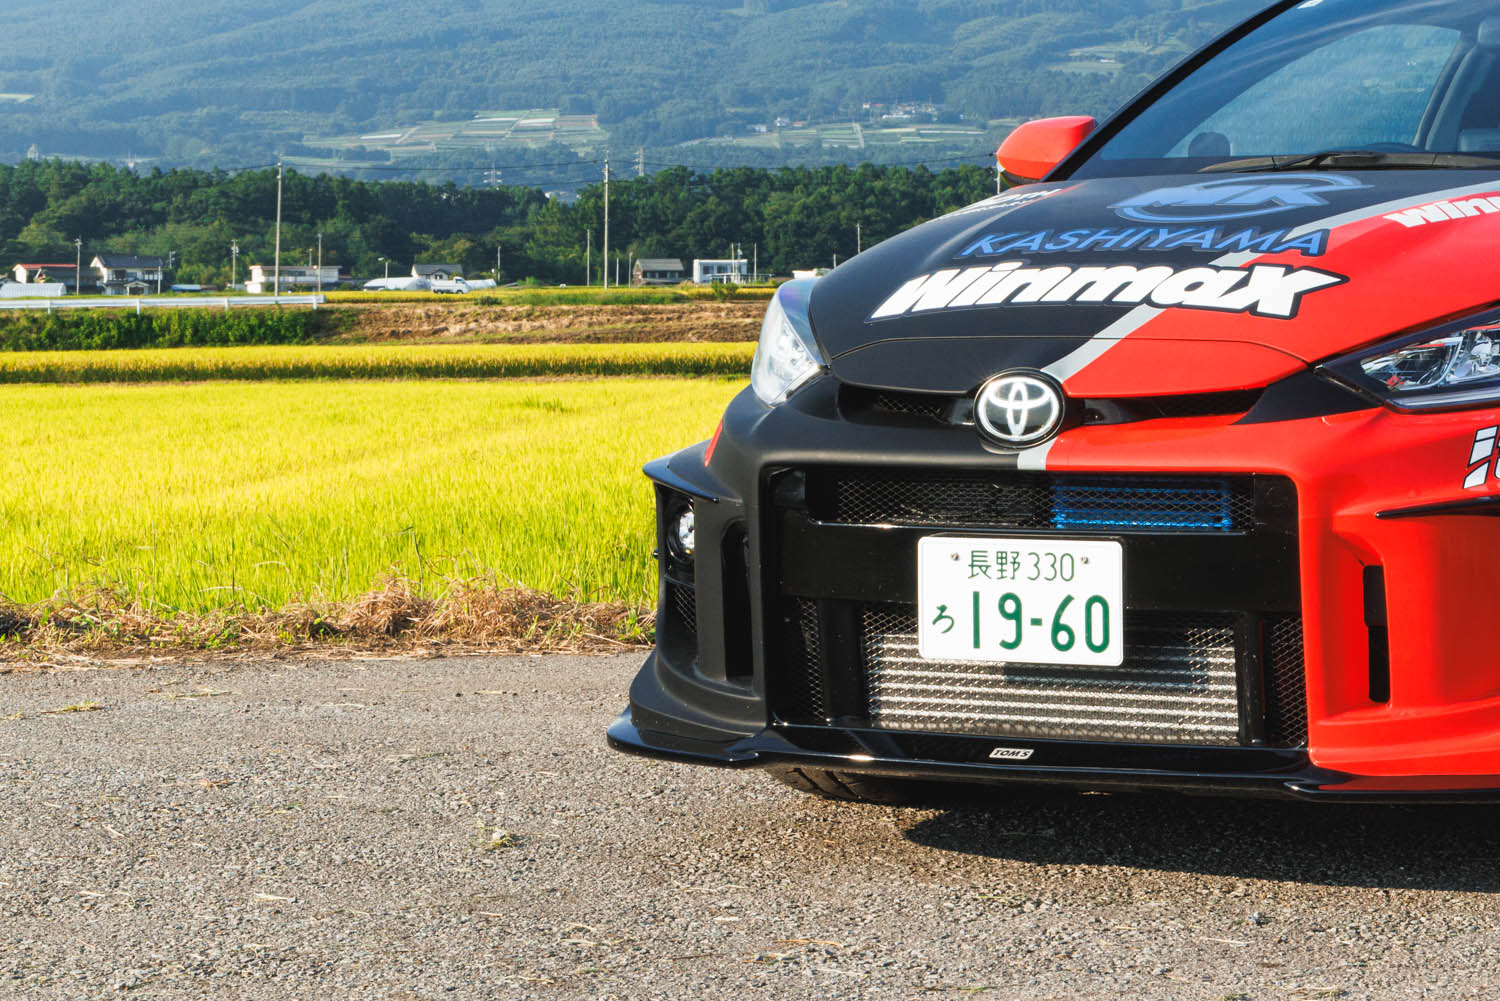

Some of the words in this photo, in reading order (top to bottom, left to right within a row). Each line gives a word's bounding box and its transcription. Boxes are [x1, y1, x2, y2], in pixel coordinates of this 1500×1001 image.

[963, 227, 1323, 255] KASHIYAMA
[968, 550, 1021, 580] 長野
[1027, 552, 1075, 582] 330
[931, 604, 955, 634] ろ
[973, 591, 1110, 654] 19-60
